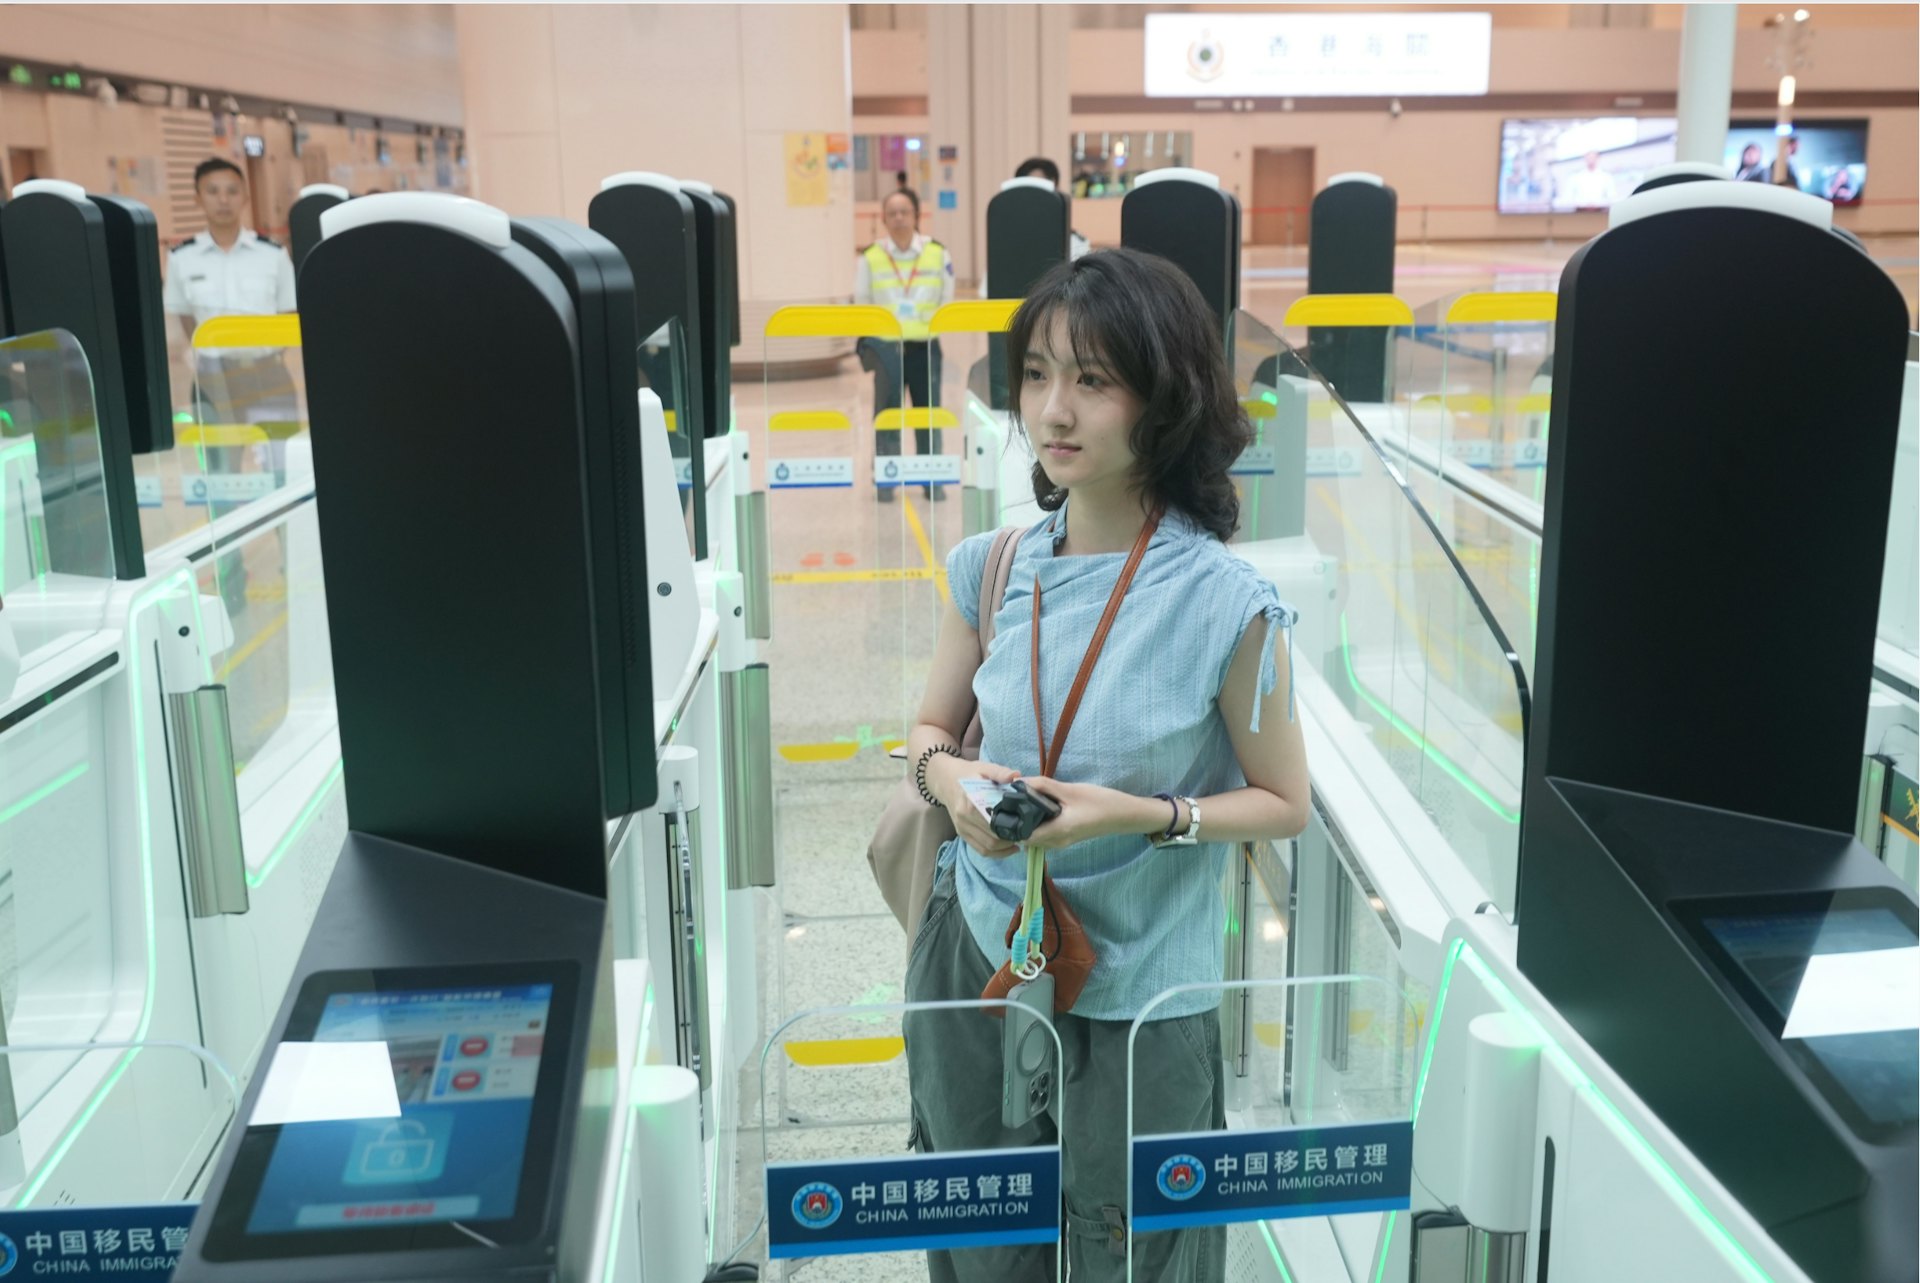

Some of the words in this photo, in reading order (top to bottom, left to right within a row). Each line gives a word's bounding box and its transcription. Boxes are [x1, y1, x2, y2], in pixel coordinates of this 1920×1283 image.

[1214, 1143, 1388, 1178] 中国移民管理
[851, 1173, 1034, 1206] 中国移民管理
[1218, 1180, 1268, 1195] CHINA
[1277, 1171, 1383, 1190] IMMIGRATION
[856, 1207, 908, 1224] CHINA
[918, 1201, 1029, 1220] IMMIGRATION
[33, 1260, 90, 1274] CHINA
[100, 1256, 180, 1271] IMMIGRA
